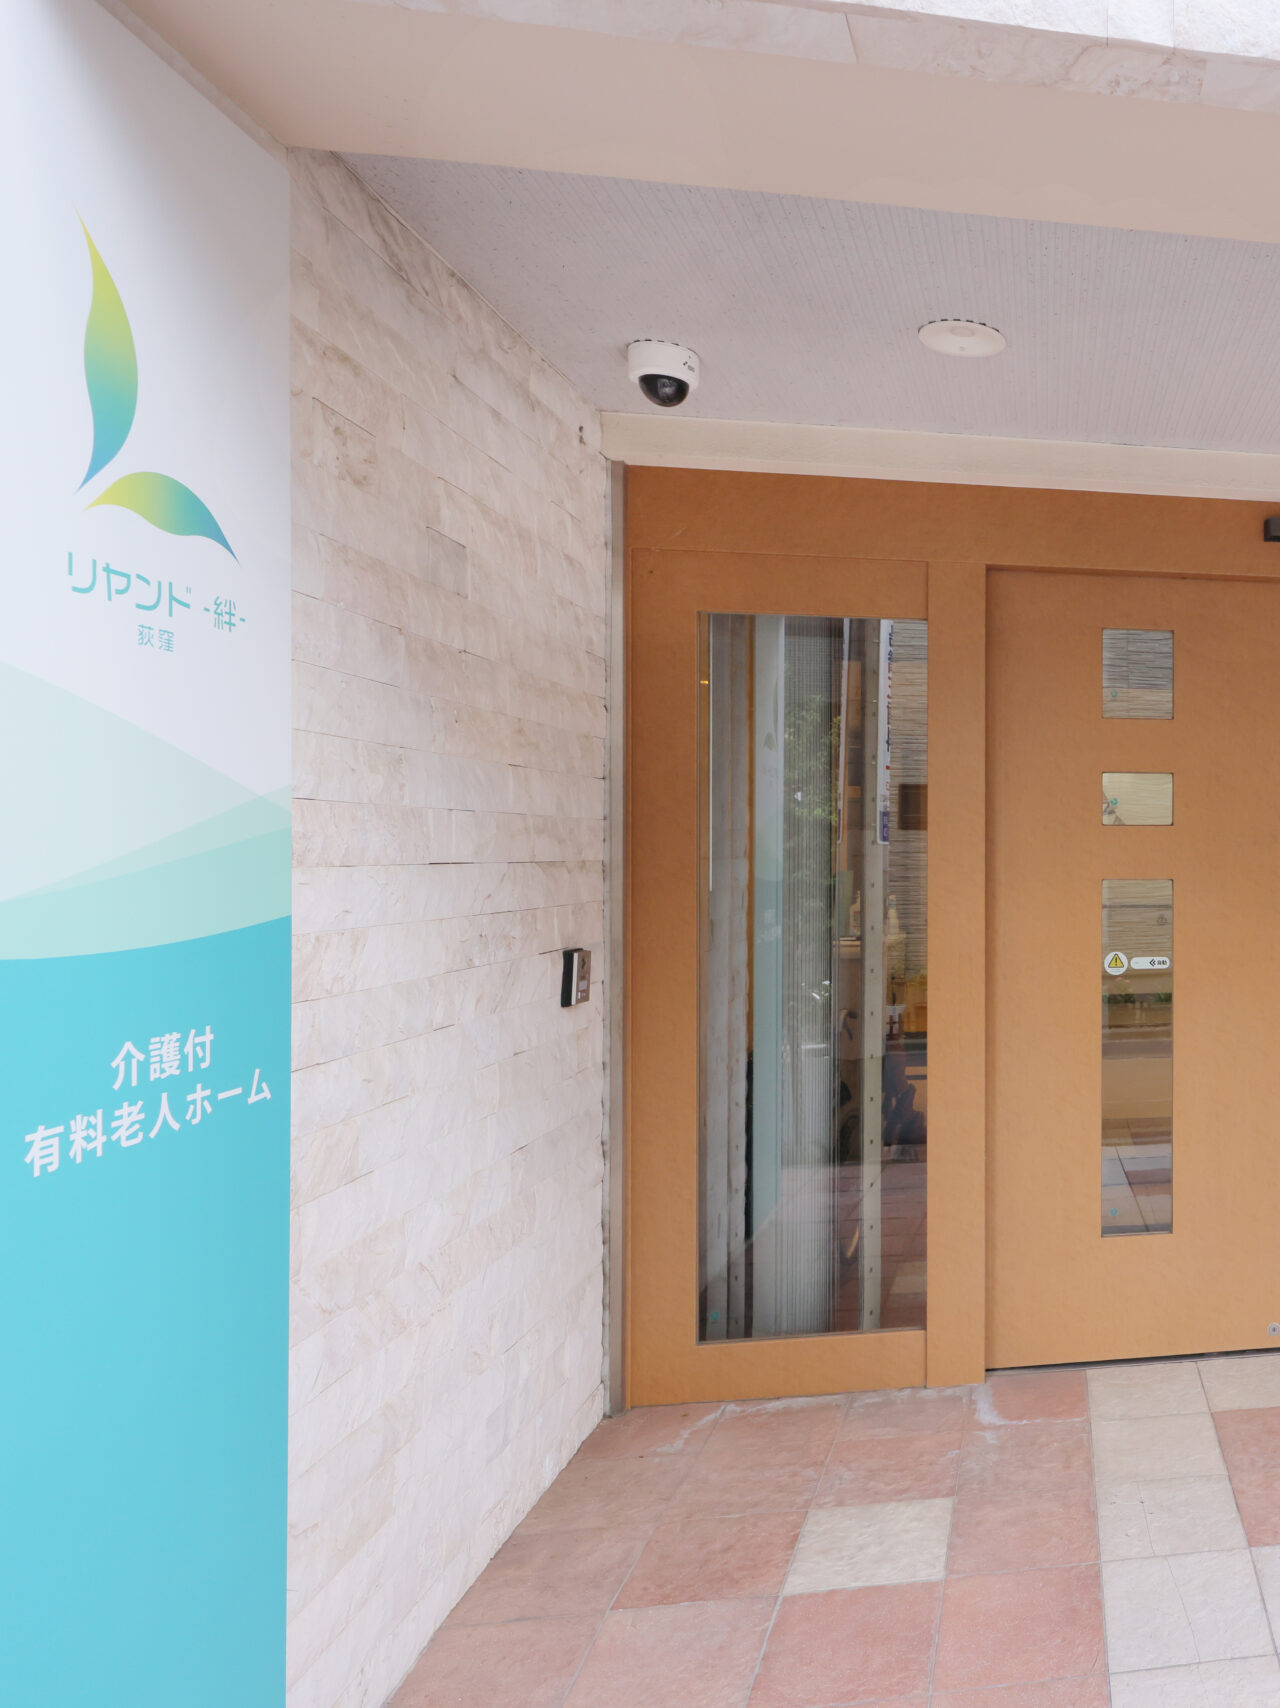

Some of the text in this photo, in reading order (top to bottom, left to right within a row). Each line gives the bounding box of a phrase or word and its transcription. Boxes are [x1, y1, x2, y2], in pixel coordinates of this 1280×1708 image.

[137, 623, 175, 653] 荻窪
[110, 1025, 214, 1091] 介護付
[24, 1068, 272, 1178] 有料老人ホーム
